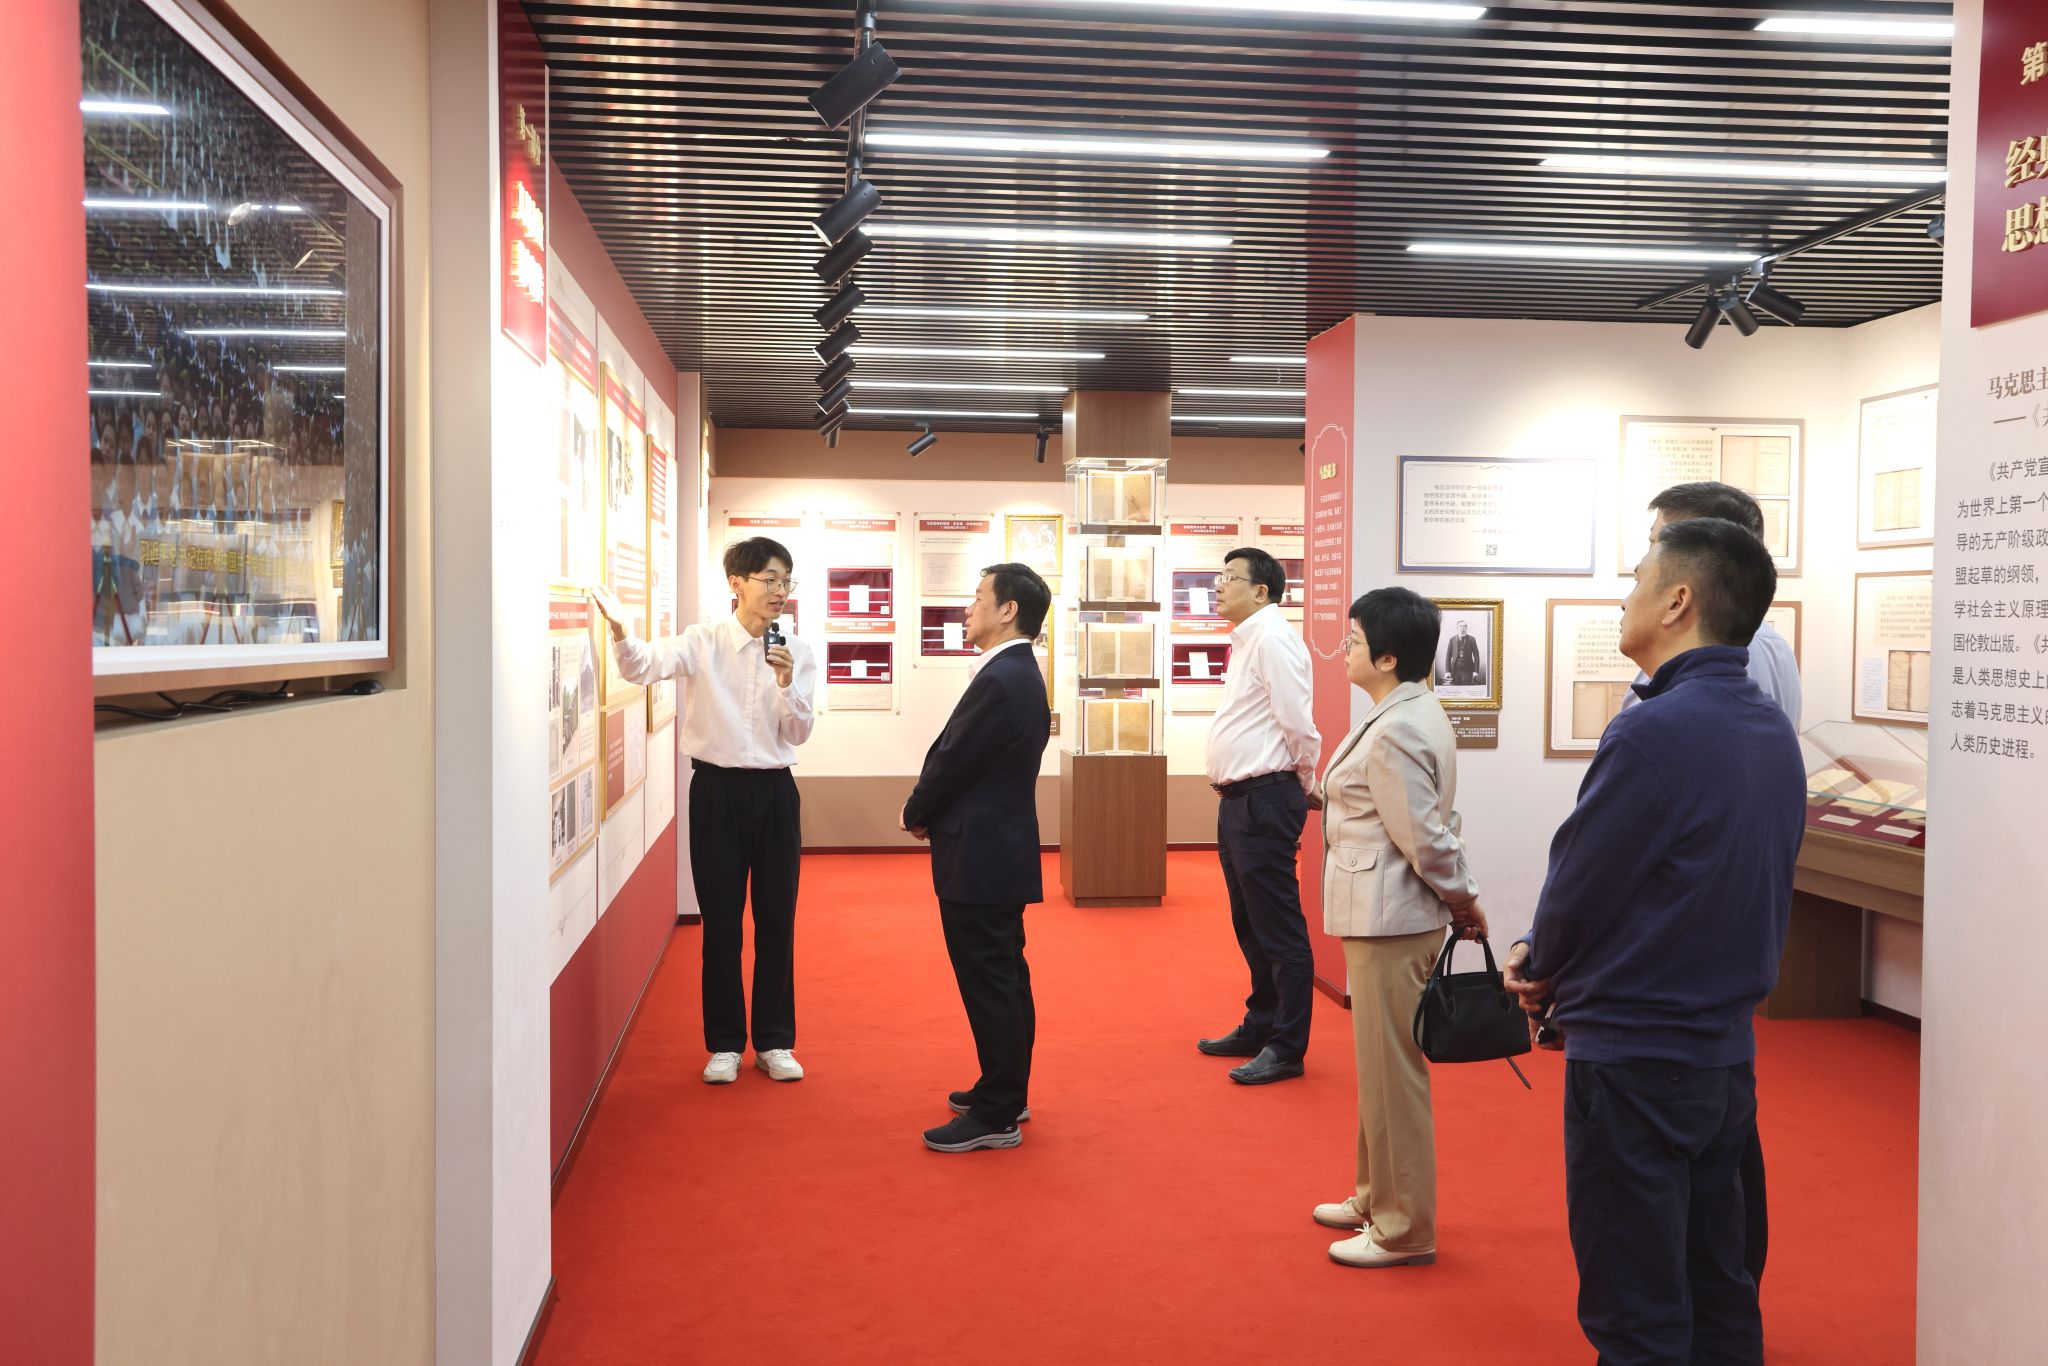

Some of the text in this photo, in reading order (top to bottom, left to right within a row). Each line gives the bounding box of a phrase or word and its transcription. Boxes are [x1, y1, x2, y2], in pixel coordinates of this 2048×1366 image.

[1957, 491, 2048, 519] 为世界上第一个
[1956, 527, 2048, 552] 导的无产阶级政
[1955, 563, 2039, 585] 盟起草的纲领，
[1954, 599, 2048, 619] 学社会主义原理
[1952, 665, 2048, 690] 是人类思想史上
[1951, 698, 2048, 726] 志着马克思主义
[1950, 732, 2035, 759] 人类历史进程。
